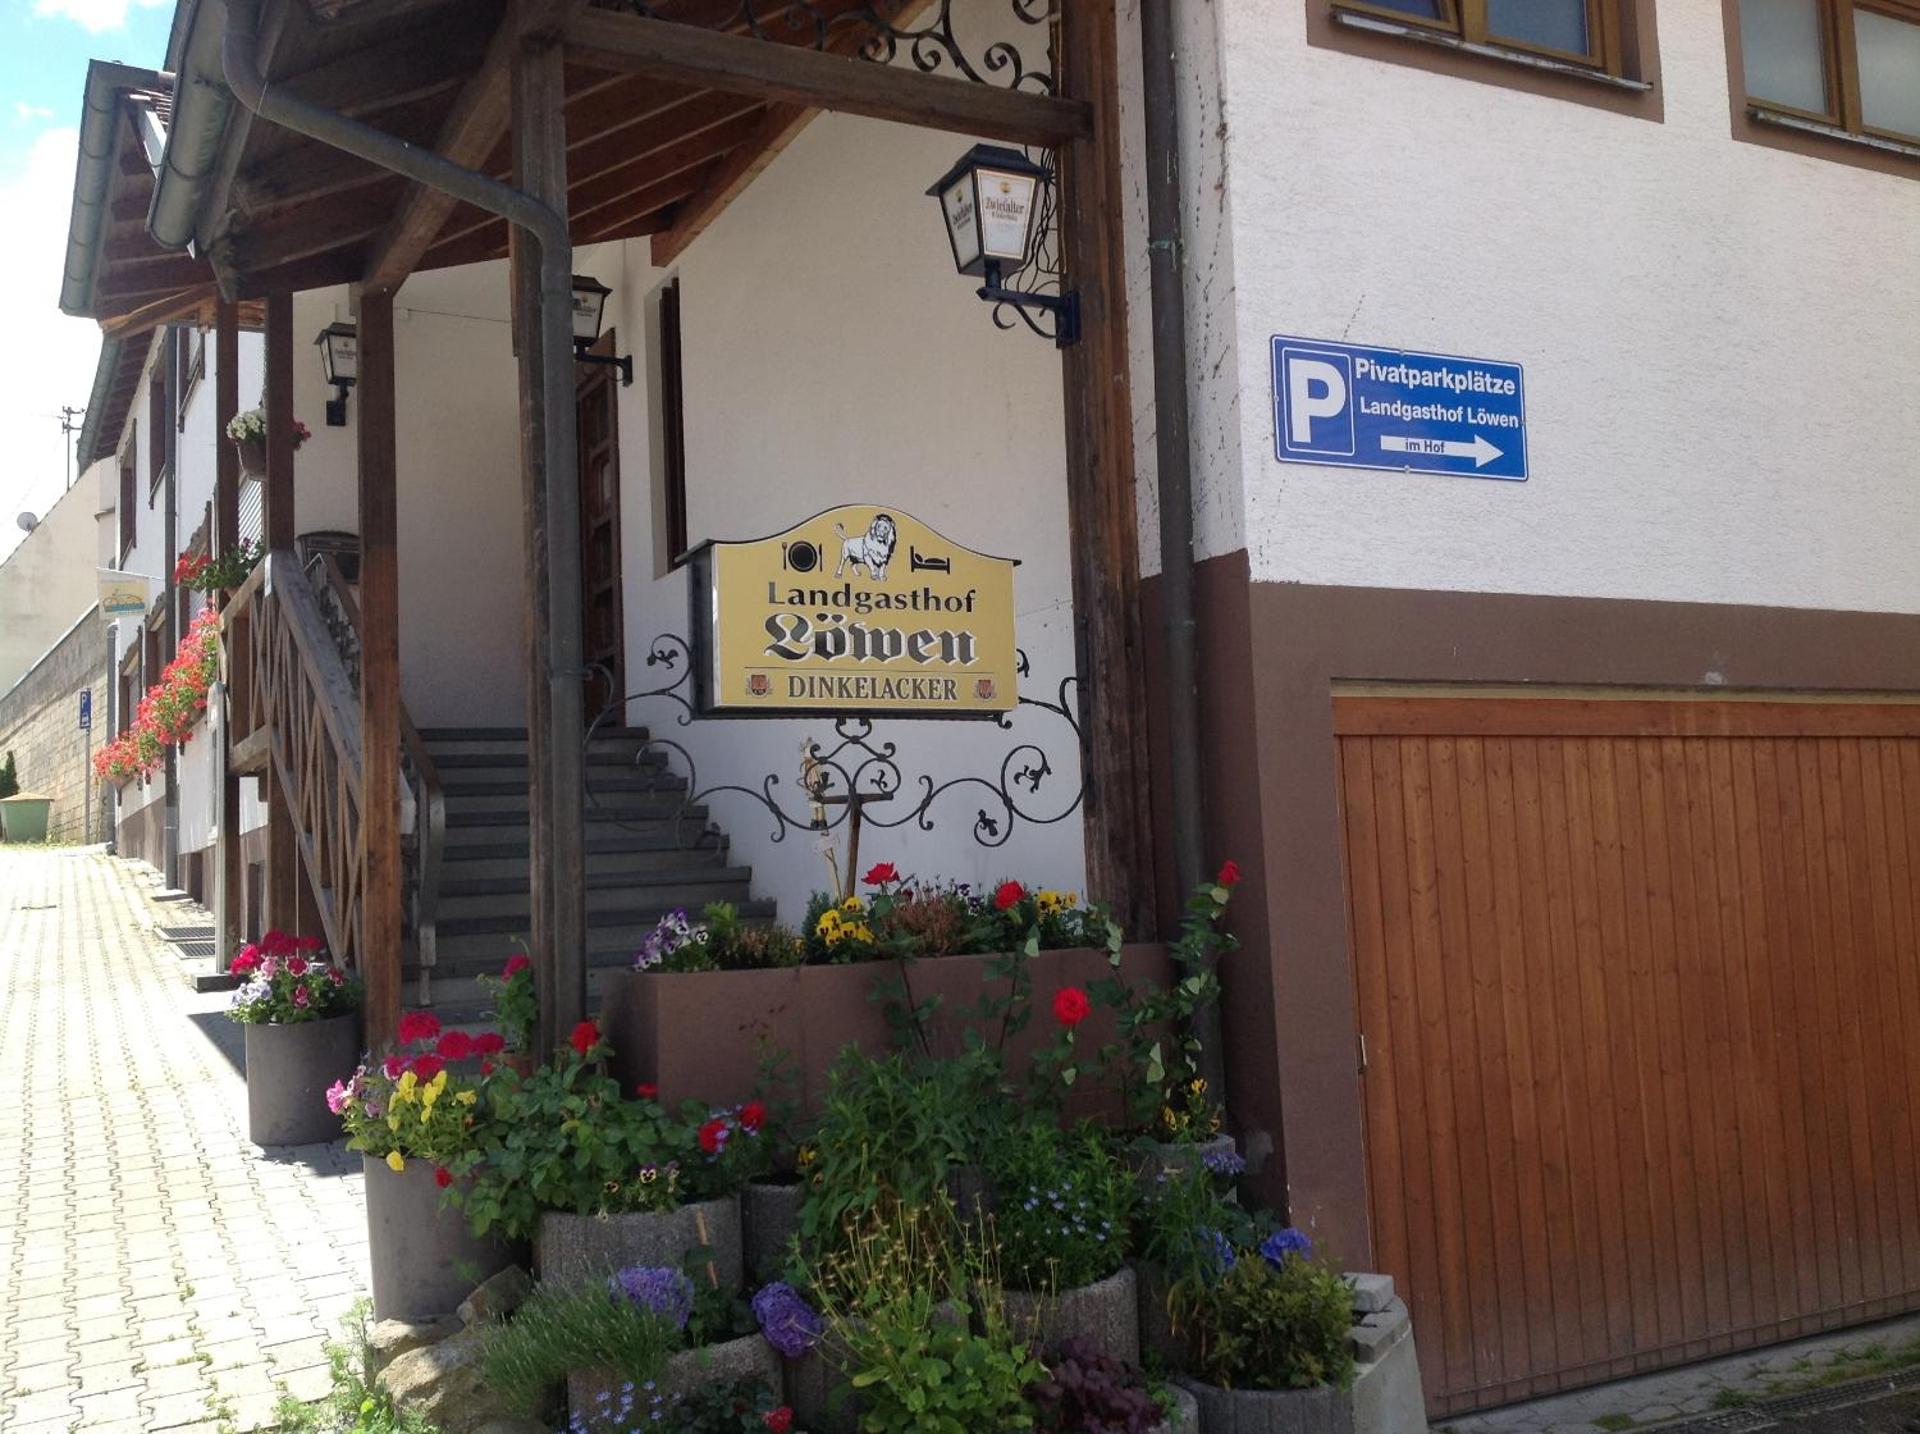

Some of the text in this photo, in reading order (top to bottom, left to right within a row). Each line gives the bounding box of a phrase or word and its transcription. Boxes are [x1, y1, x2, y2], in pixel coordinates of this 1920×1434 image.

[1355, 358, 1516, 395] Pivatparkplätze
[1289, 358, 1346, 443] P
[1361, 396, 1519, 428] Landgasthof Löwen
[1405, 438, 1445, 454] im Hof
[769, 582, 976, 615] Landgasthof
[764, 612, 979, 665] Löwen
[788, 676, 958, 701] DINKELACKER
